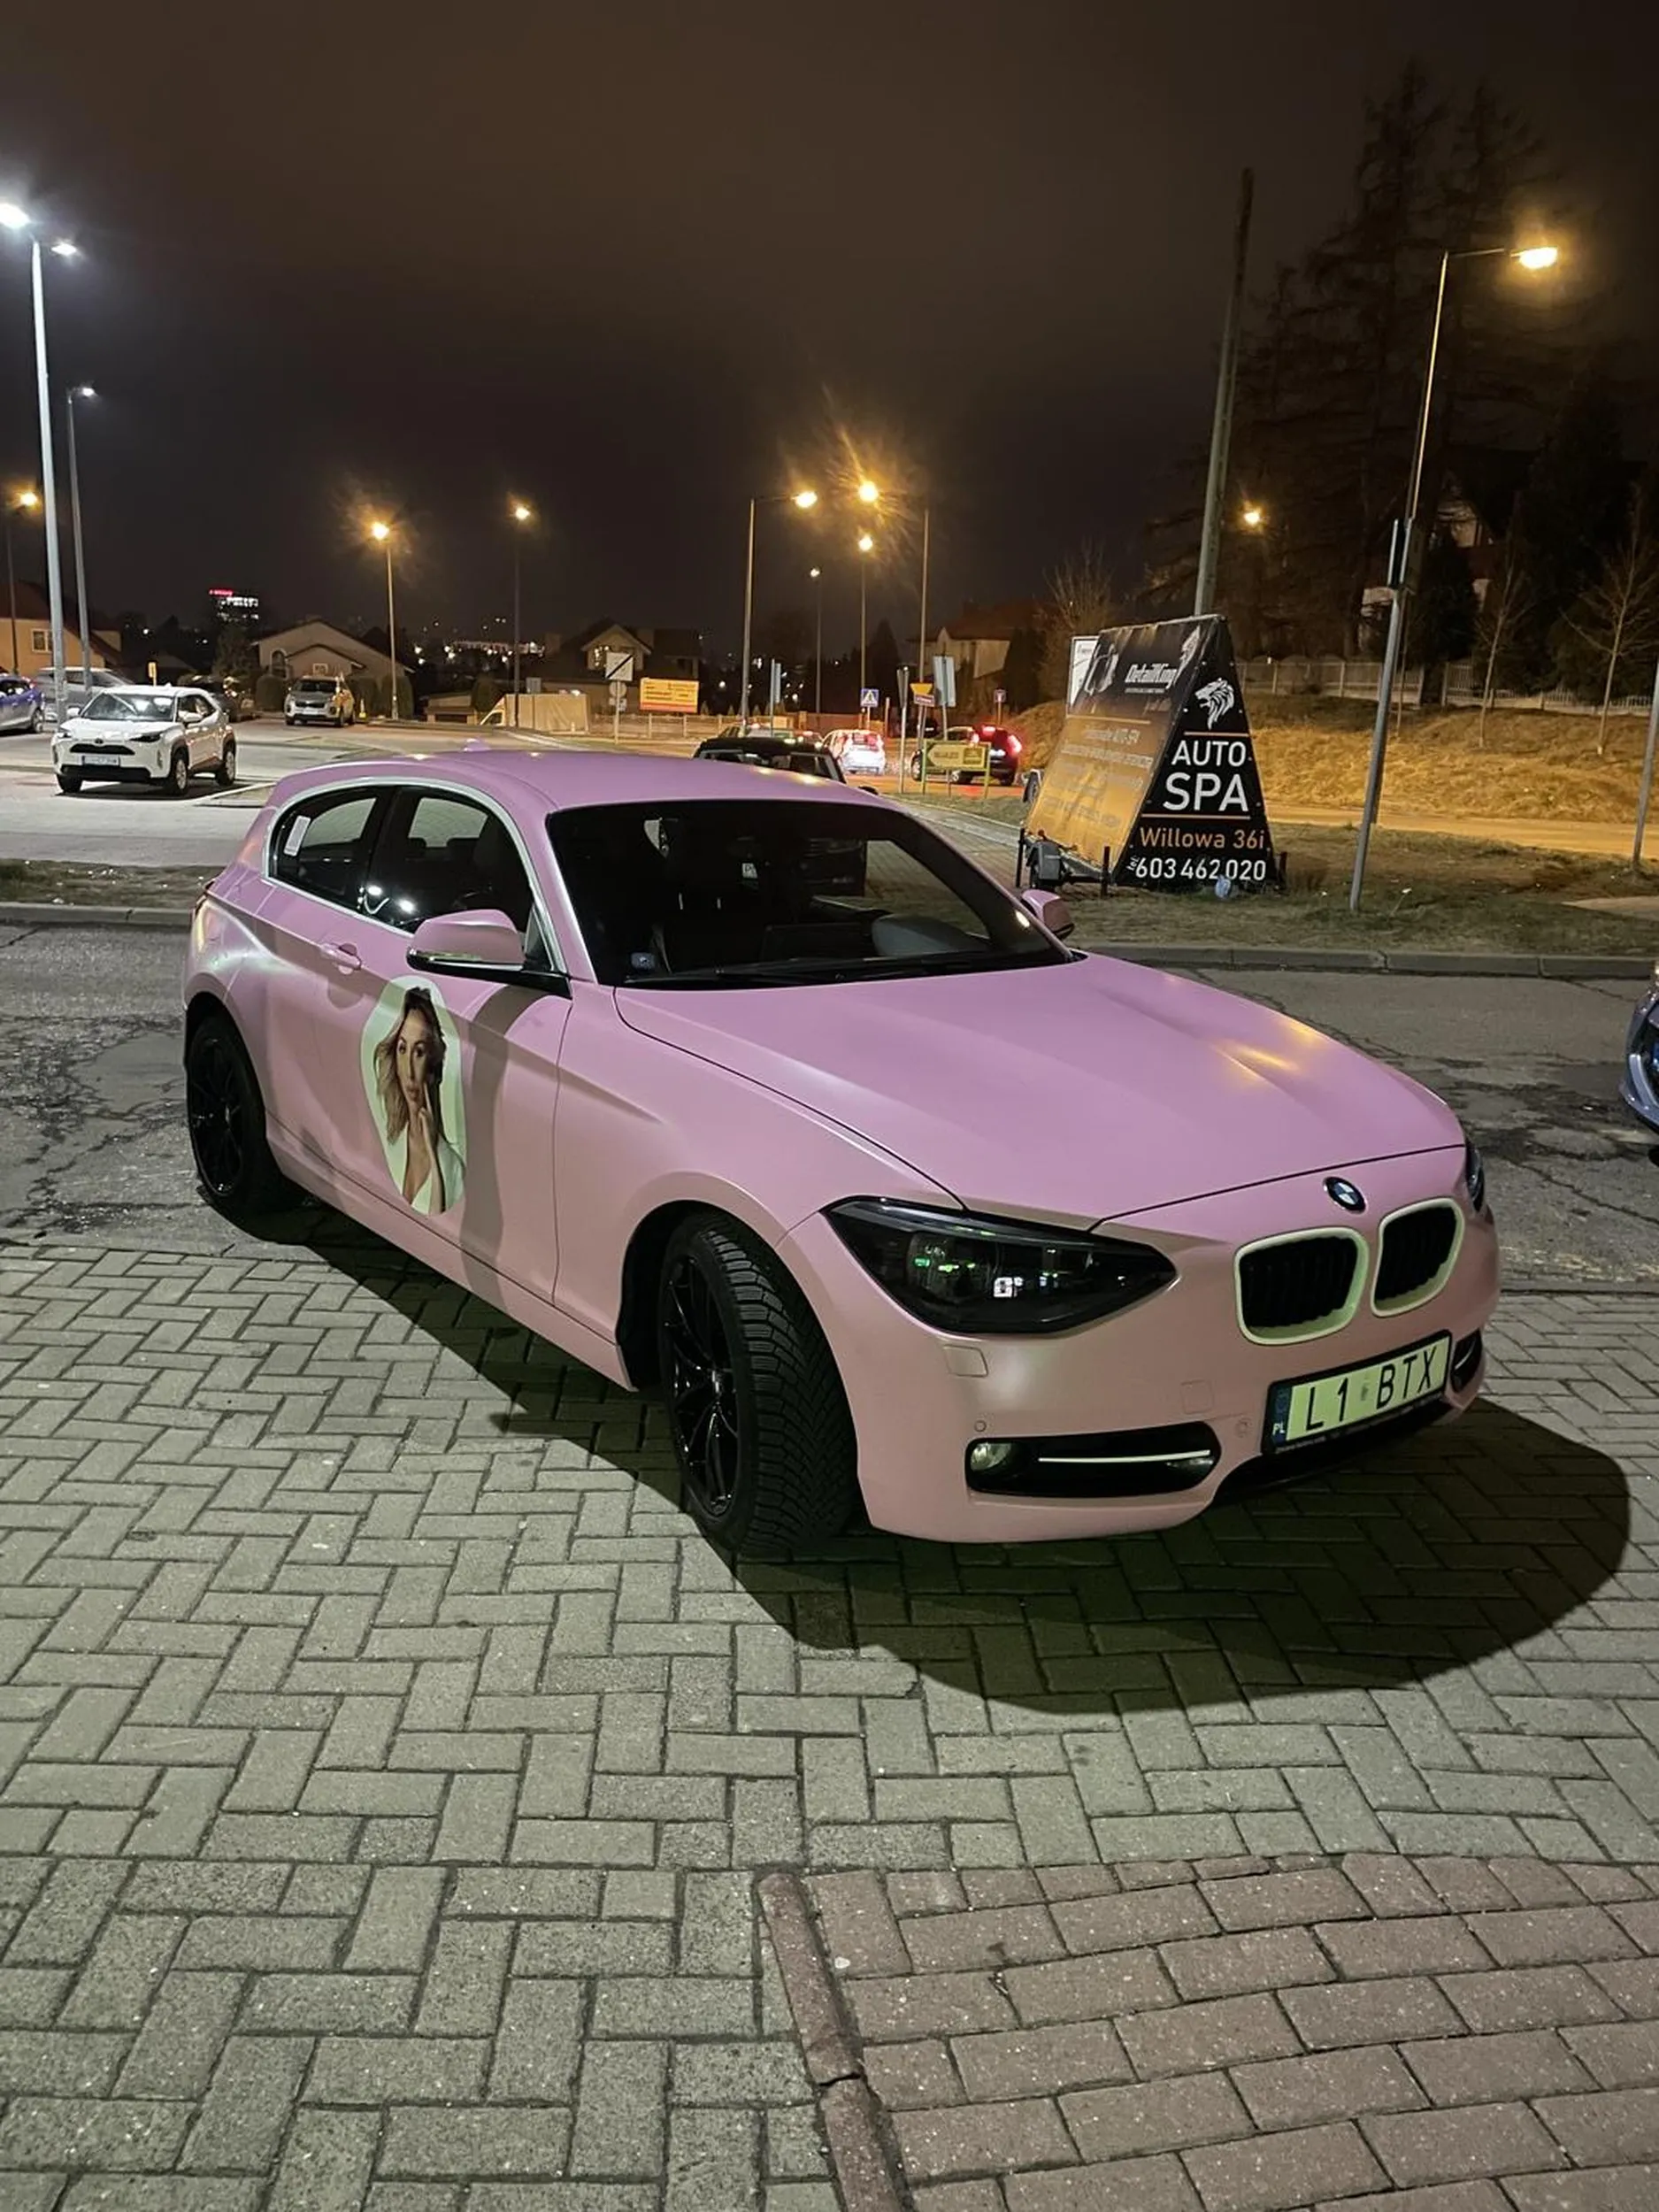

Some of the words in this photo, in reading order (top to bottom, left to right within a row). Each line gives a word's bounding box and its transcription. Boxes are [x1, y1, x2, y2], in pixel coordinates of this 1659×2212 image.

[1171, 740, 1246, 766] AUTO
[1163, 772, 1248, 811] SPA
[1140, 826, 1225, 849] Willowa
[1233, 828, 1264, 849] 36i
[1135, 857, 1176, 879] 603
[1180, 858, 1221, 879] 462
[1225, 859, 1266, 880] 020
[1306, 1377, 1348, 1431] L1
[1377, 1346, 1437, 1409] BTX
[1272, 1421, 1286, 1435] PL
